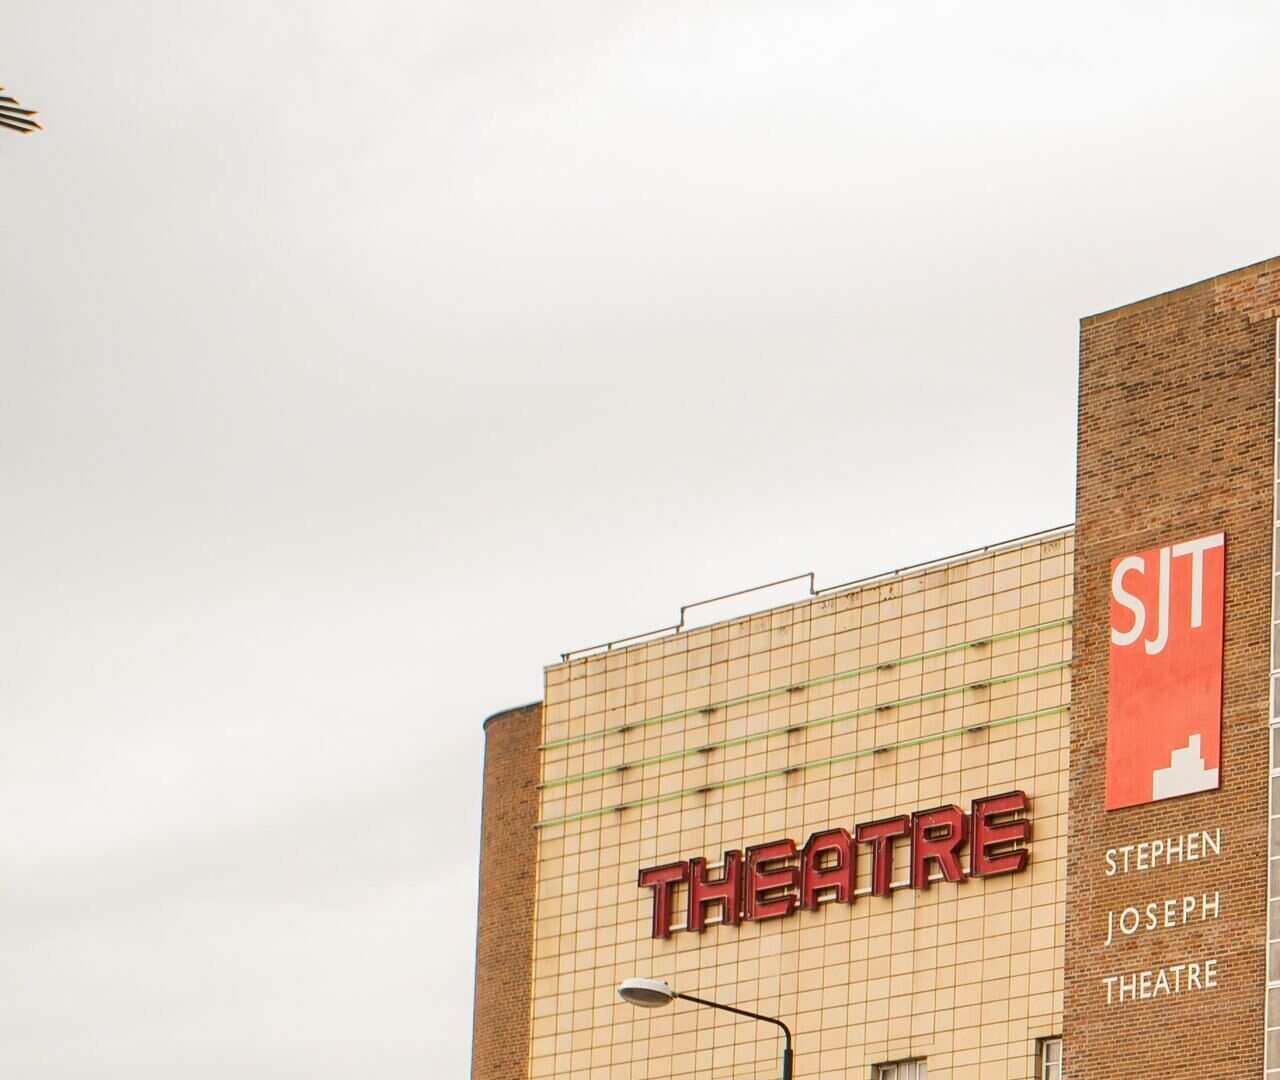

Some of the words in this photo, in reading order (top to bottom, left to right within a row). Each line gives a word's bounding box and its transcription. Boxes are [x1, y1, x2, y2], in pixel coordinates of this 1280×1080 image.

[1109, 532, 1225, 656] SJT
[637, 789, 1032, 940] THEATRE
[1104, 827, 1223, 877] STEPHEN
[1103, 890, 1221, 946] JOSEPH
[1101, 958, 1219, 1005] THEATRE
